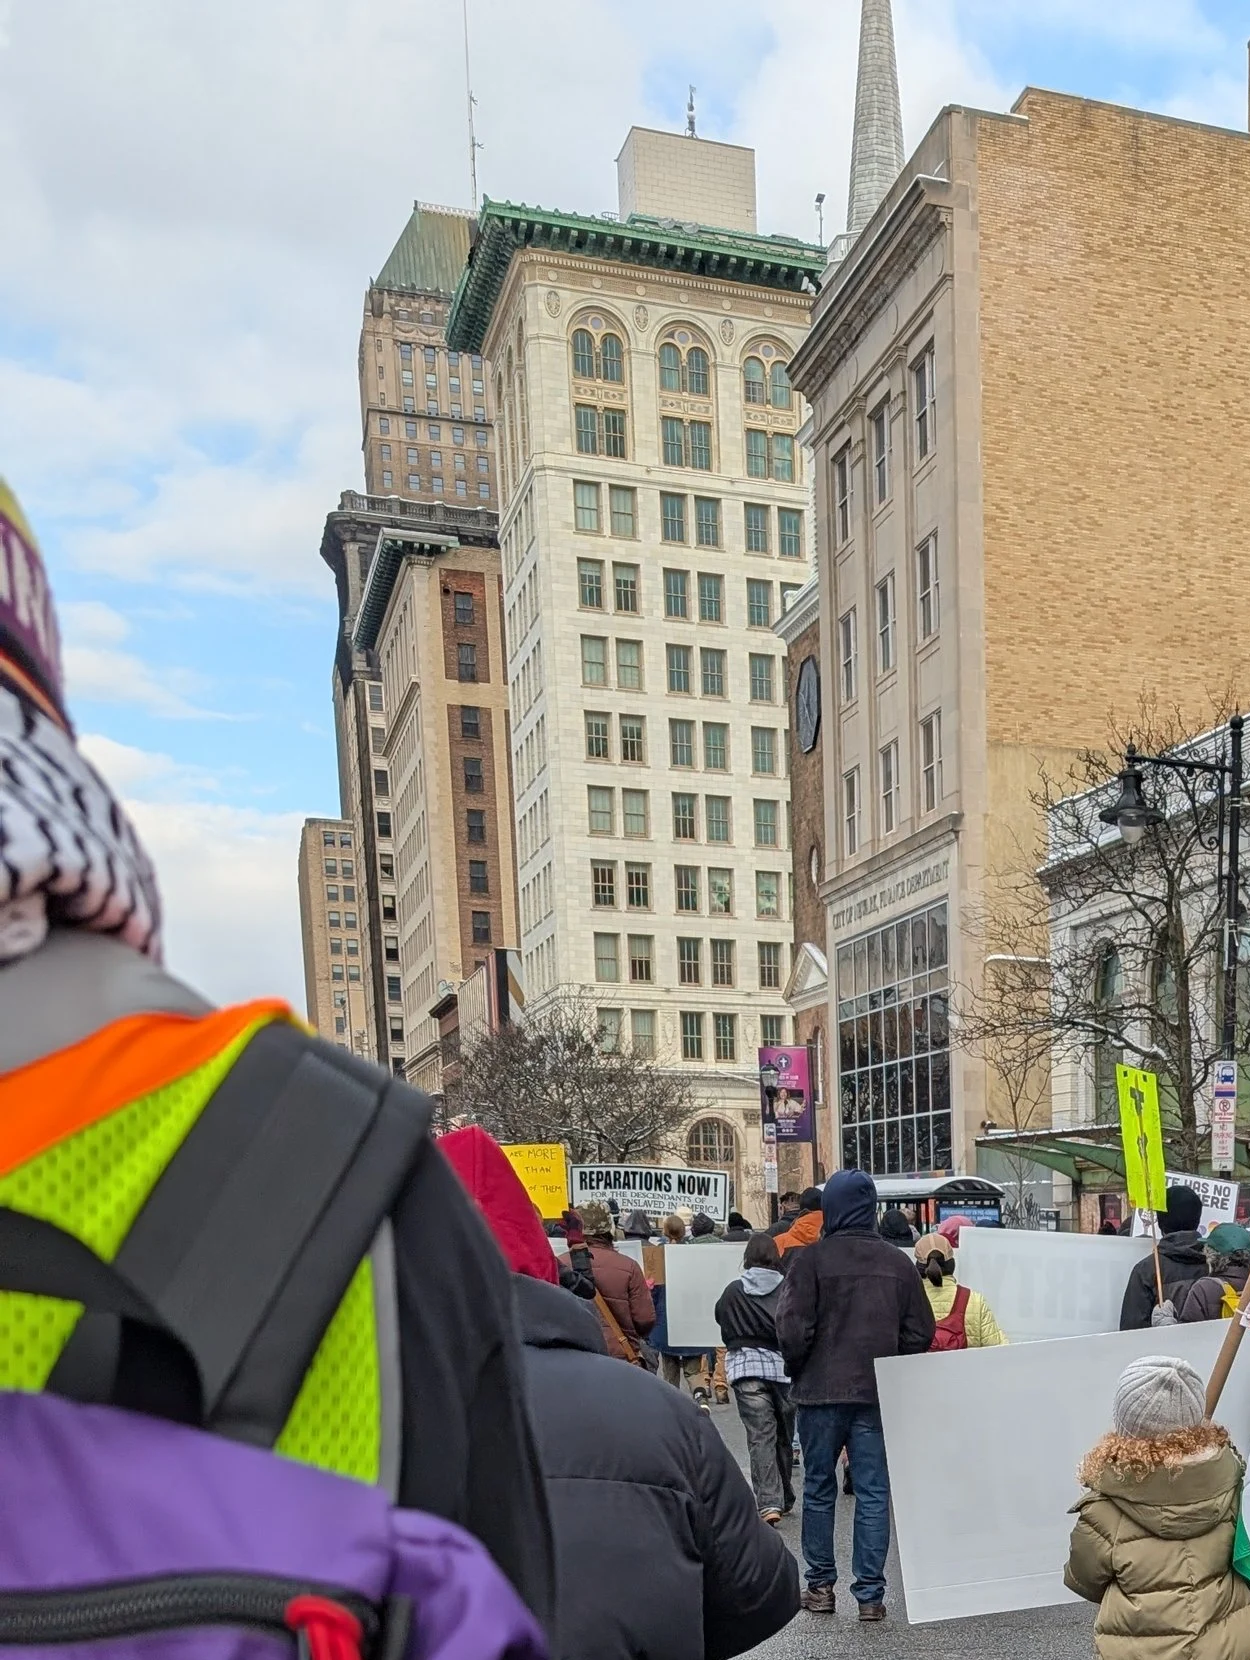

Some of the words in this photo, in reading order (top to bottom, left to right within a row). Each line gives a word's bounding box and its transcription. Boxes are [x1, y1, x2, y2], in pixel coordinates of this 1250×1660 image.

[527, 1148, 557, 1160] MORE
[579, 1170, 672, 1192] REPARATIONS
[1213, 1184, 1231, 1197] NO
[630, 1192, 691, 1202] DESCENDANTS
[1200, 1194, 1230, 1210] ERE
[621, 1199, 665, 1209] ENSLAVED
